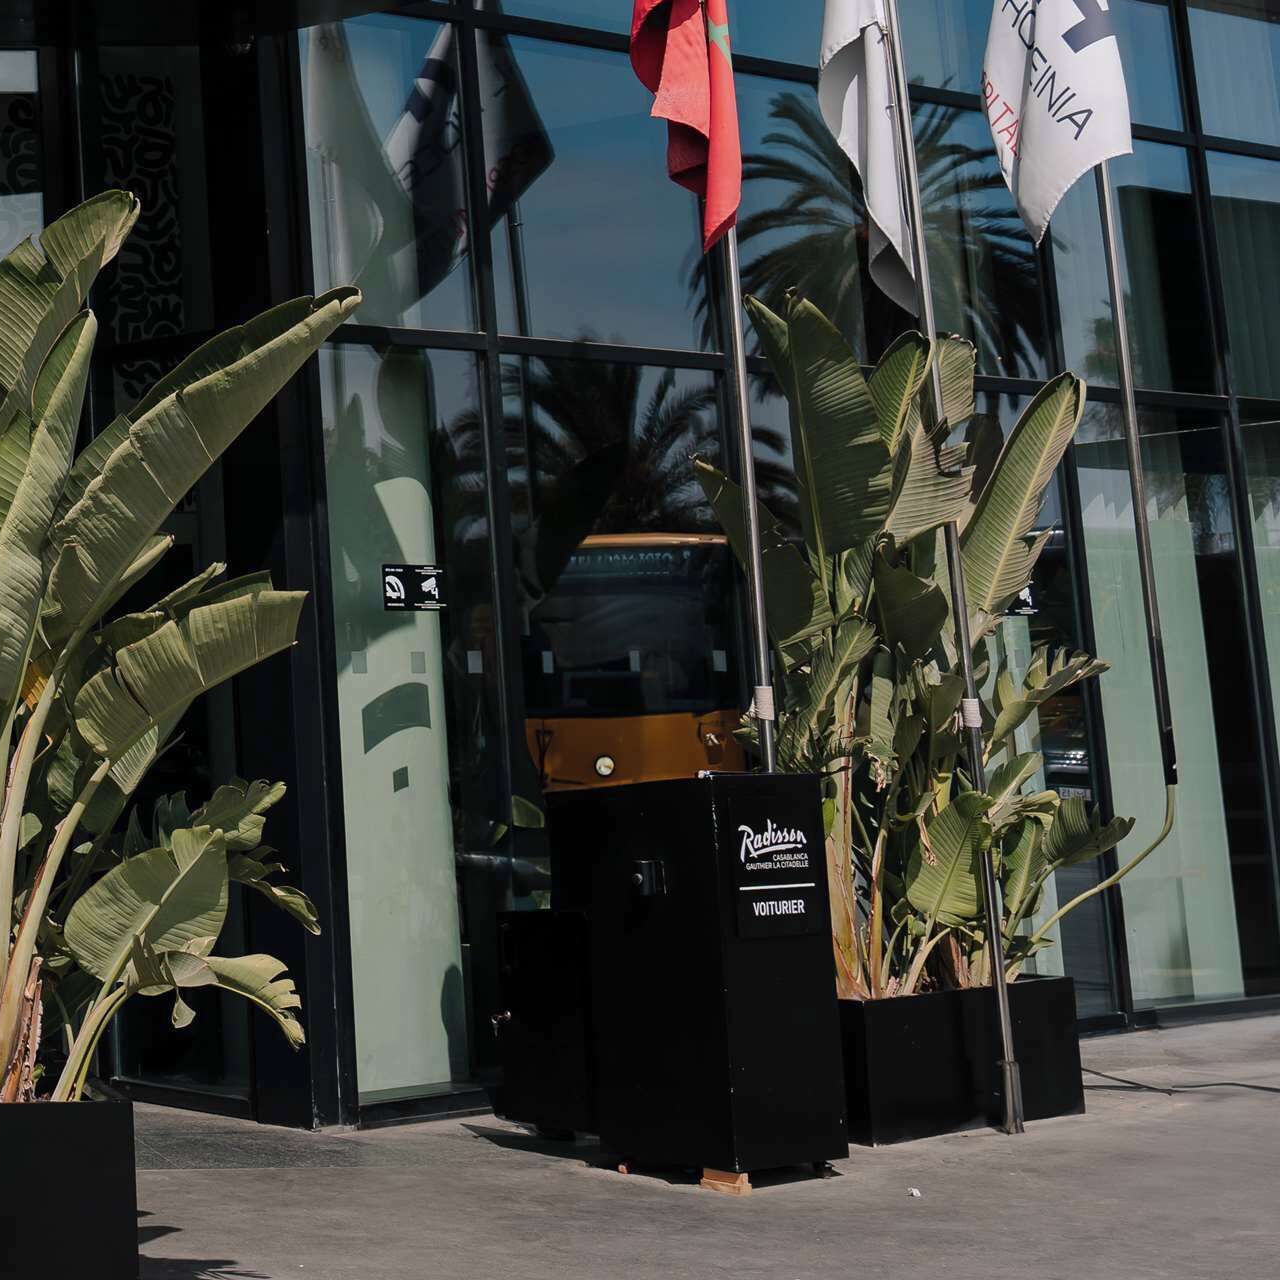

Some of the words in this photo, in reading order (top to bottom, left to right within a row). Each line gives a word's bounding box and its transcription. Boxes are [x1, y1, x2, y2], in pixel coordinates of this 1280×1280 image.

[738, 818, 807, 863] Radisson
[772, 852, 808, 861] CASABLANCA
[745, 861, 772, 870] GAUTHIER
[773, 861, 781, 869] LA
[781, 860, 809, 868] CITADELLE
[752, 899, 805, 917] VOITURIER
